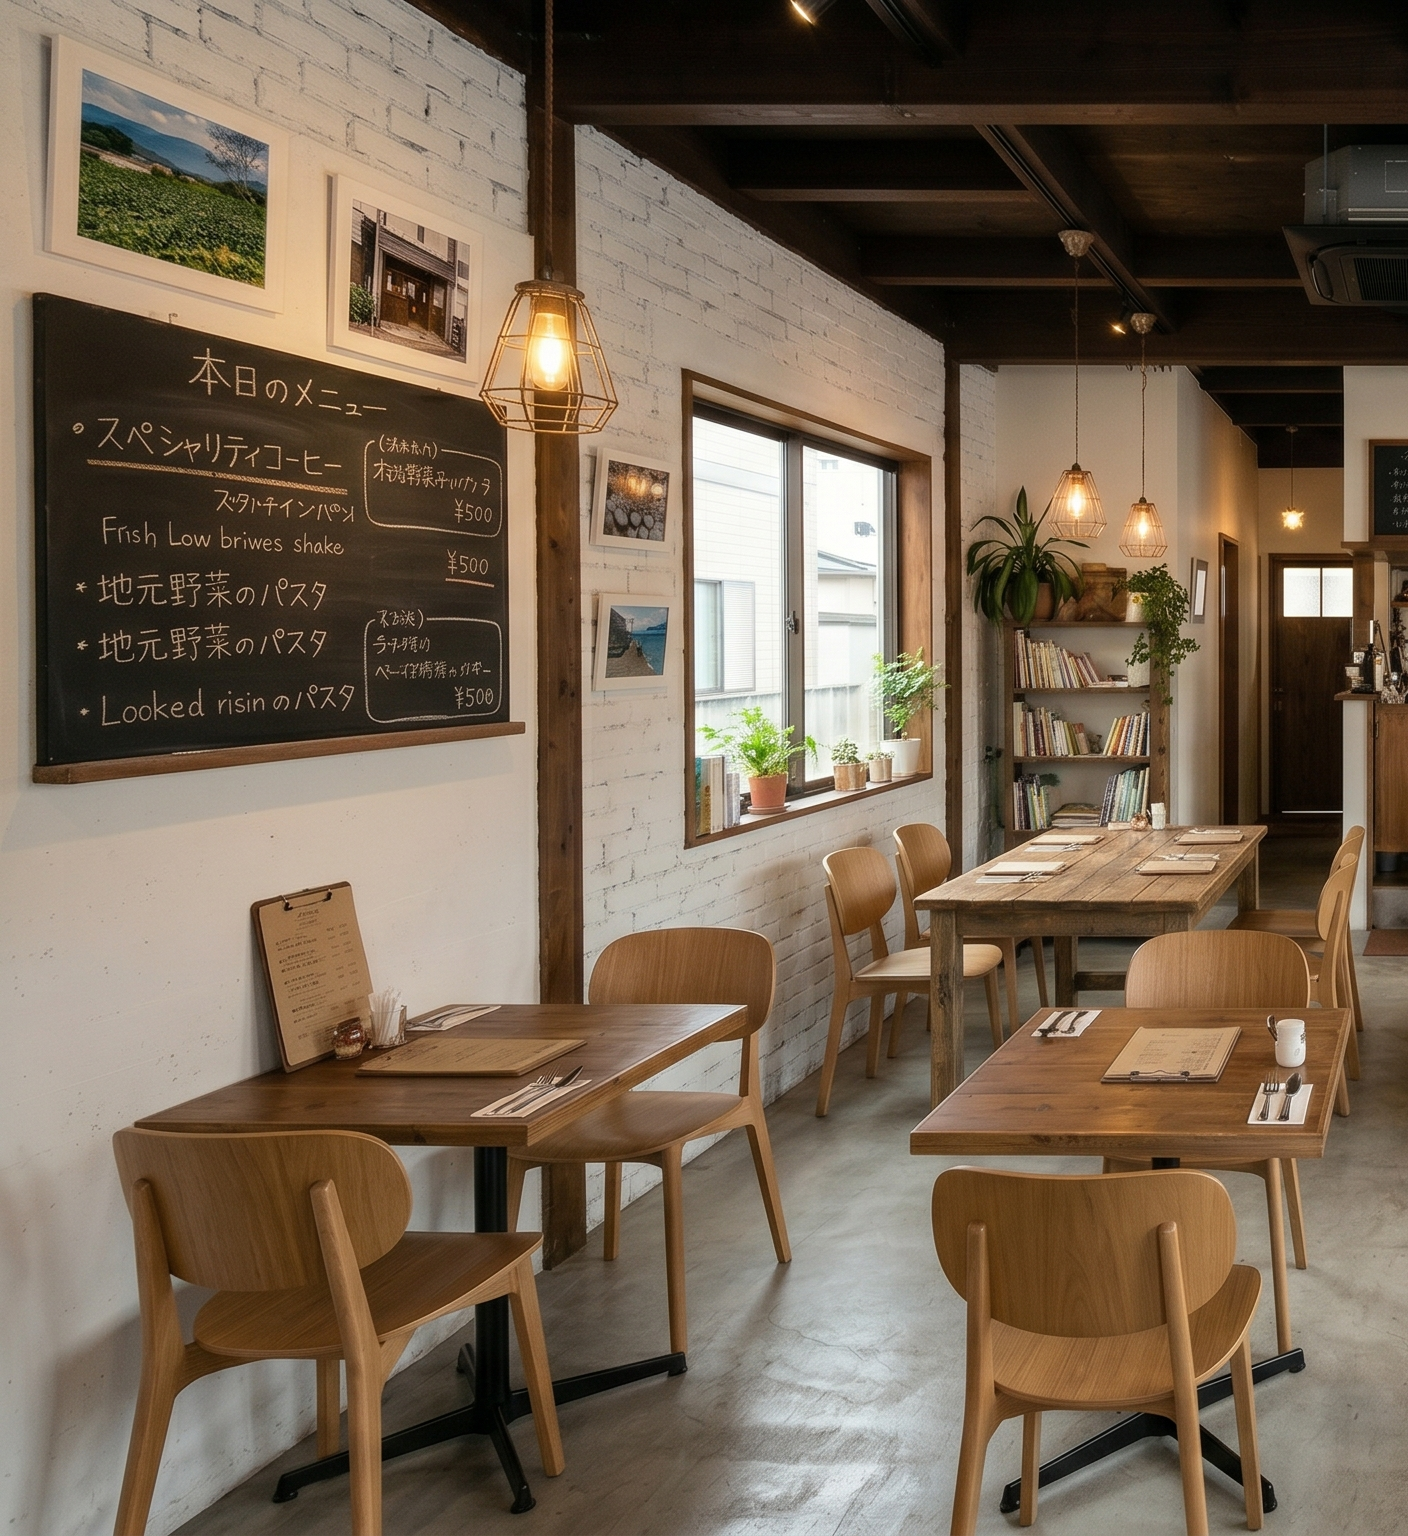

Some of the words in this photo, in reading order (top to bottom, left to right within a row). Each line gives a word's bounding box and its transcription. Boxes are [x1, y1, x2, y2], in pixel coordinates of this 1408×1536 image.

[188, 347, 387, 417] 本日のメニュー
[97, 417, 342, 475] スペシャリティコーヒー
[454, 497, 493, 524] ¥500
[168, 520, 212, 548] Low
[220, 525, 283, 552] briwes
[293, 532, 345, 555] shake
[446, 548, 489, 576] ¥500
[96, 569, 327, 611] 地元野菜のパスタ
[97, 622, 327, 663] 地元野菜のパスタ
[101, 687, 205, 727] Looked
[217, 690, 265, 715] risin
[272, 684, 355, 712] のパスタ
